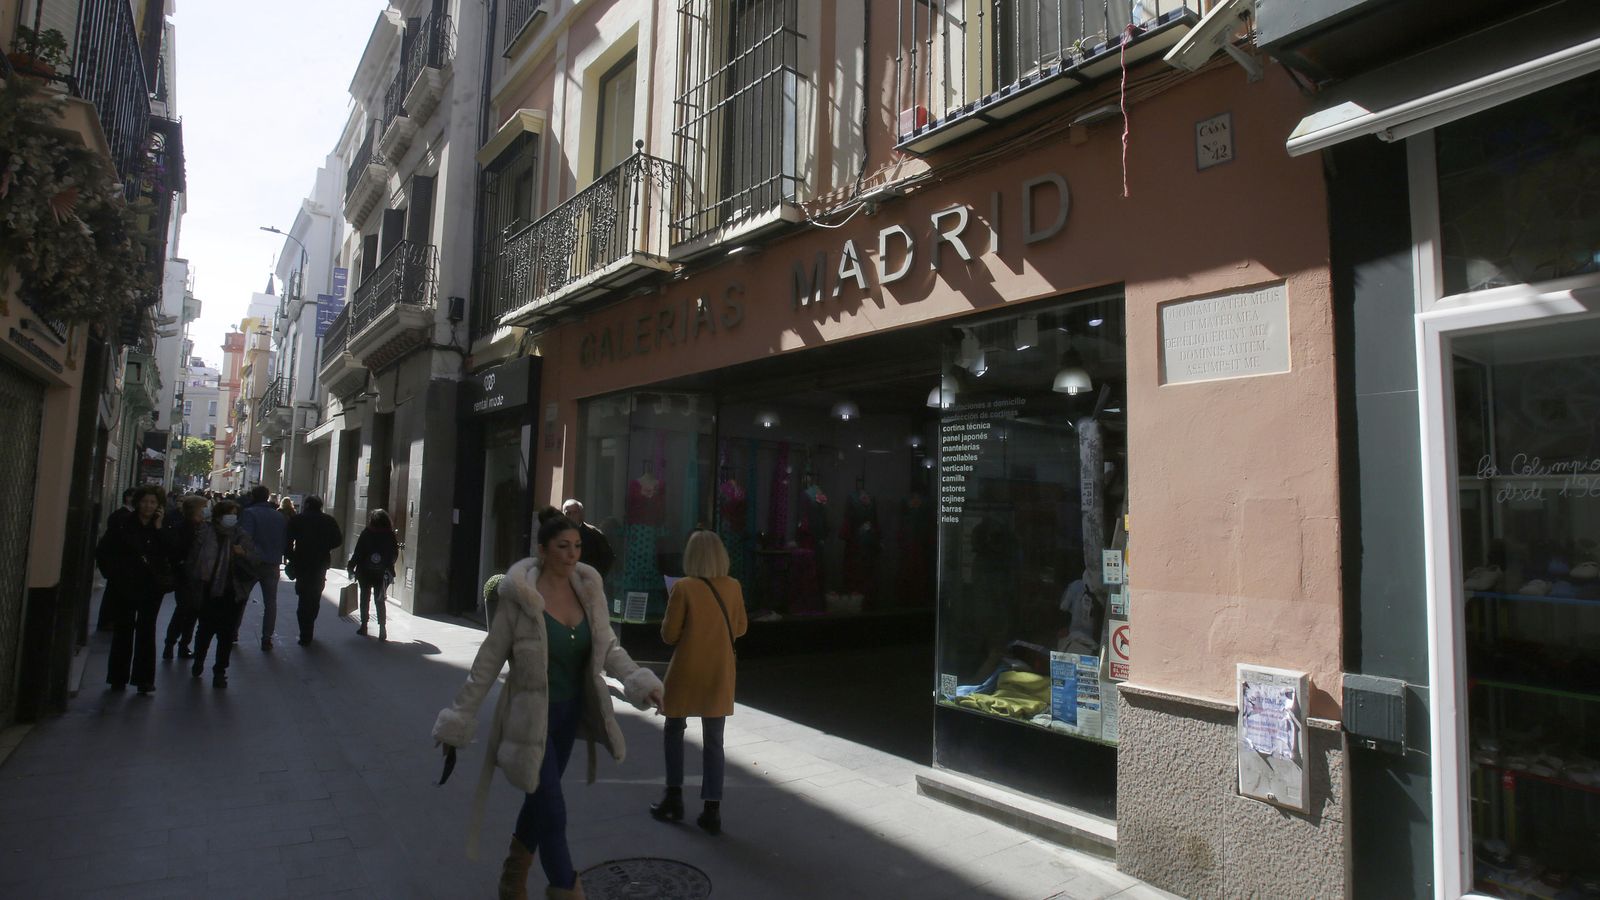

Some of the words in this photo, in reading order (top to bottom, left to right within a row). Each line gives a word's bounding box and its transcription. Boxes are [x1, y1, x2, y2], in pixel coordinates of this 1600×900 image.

[1199, 122, 1227, 137] CASA
[579, 279, 745, 370] GALERIAS
[791, 172, 1070, 307] MADRID
[1214, 296, 1249, 311] PATER
[1251, 290, 1280, 305] MEUS
[1184, 319, 1196, 332] ET
[1198, 313, 1234, 330] MATER
[1237, 309, 1260, 325] MEA
[1250, 323, 1265, 337] ME
[1180, 345, 1226, 361] DOMINUS
[1244, 356, 1261, 369] ME
[993, 396, 1026, 408] domicilio
[942, 423, 965, 433] cortina
[966, 421, 991, 431] técnica
[942, 433, 960, 444] panel
[961, 431, 987, 442] japonés
[942, 453, 979, 463] enrollables
[942, 464, 974, 472] verticales
[942, 474, 965, 482] camilla
[942, 485, 966, 493] estores
[942, 494, 966, 504] cojines
[942, 504, 963, 513] barras
[942, 514, 960, 523] rieles
